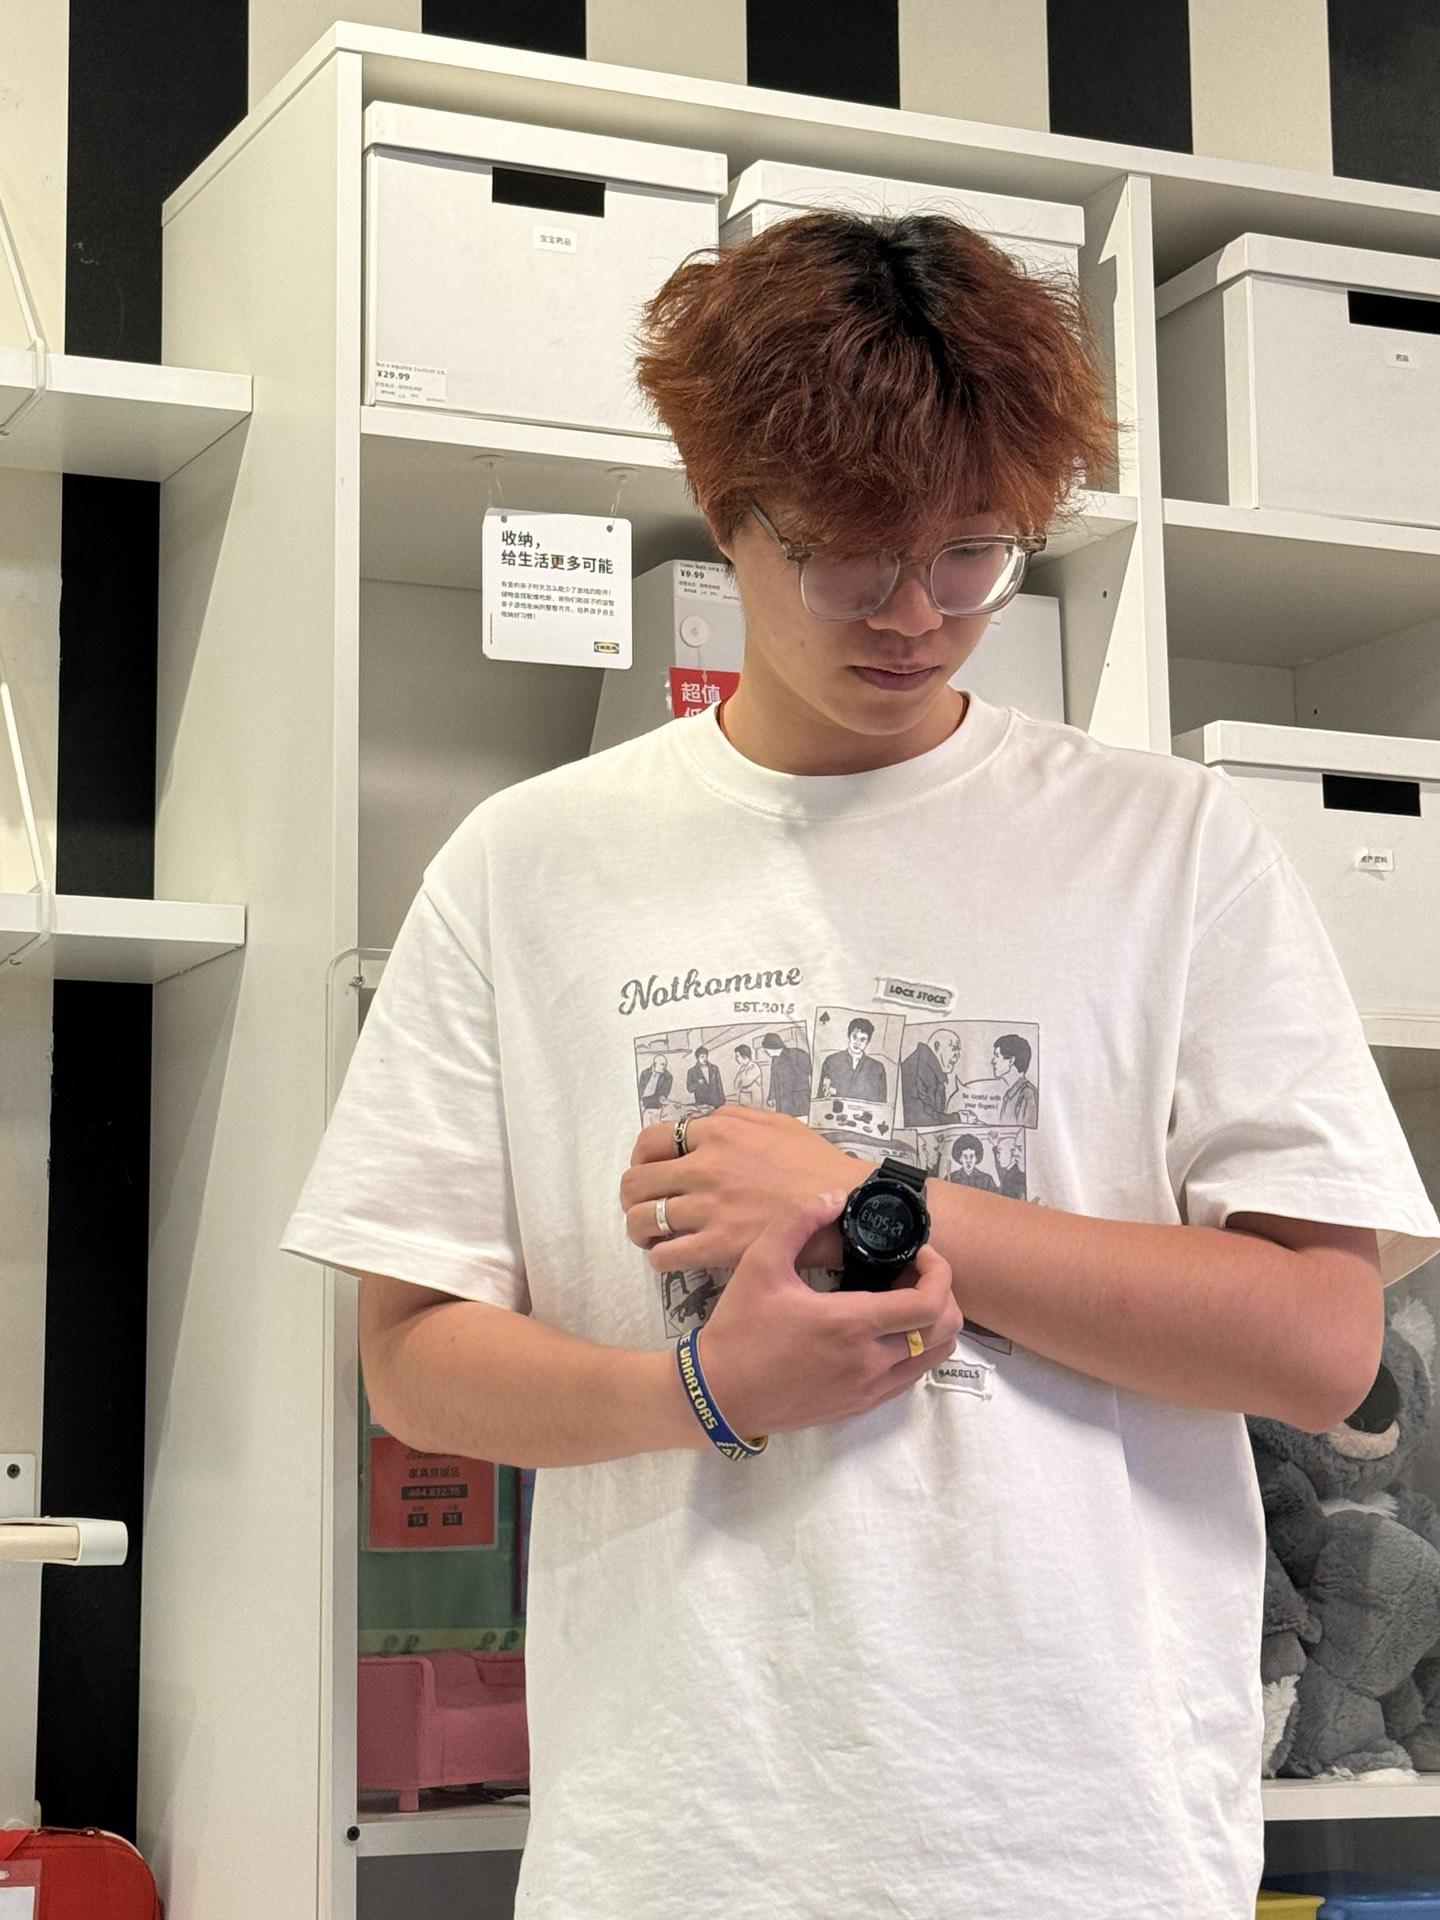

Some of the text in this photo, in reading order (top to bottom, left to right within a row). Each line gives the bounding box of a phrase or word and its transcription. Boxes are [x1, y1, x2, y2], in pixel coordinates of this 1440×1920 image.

[377, 370, 410, 381] ¥29.99
[501, 549, 614, 575] 给生活更多可能
[680, 569, 705, 579] ¥9.99
[681, 682, 720, 704] 超值
[618, 967, 801, 1016] Nothomme
[889, 985, 947, 1005] LOCK STOCK
[734, 1002, 795, 1014] EST.2015
[938, 1369, 980, 1379] BARRELS
[680, 1346, 718, 1430] WARRIORS
